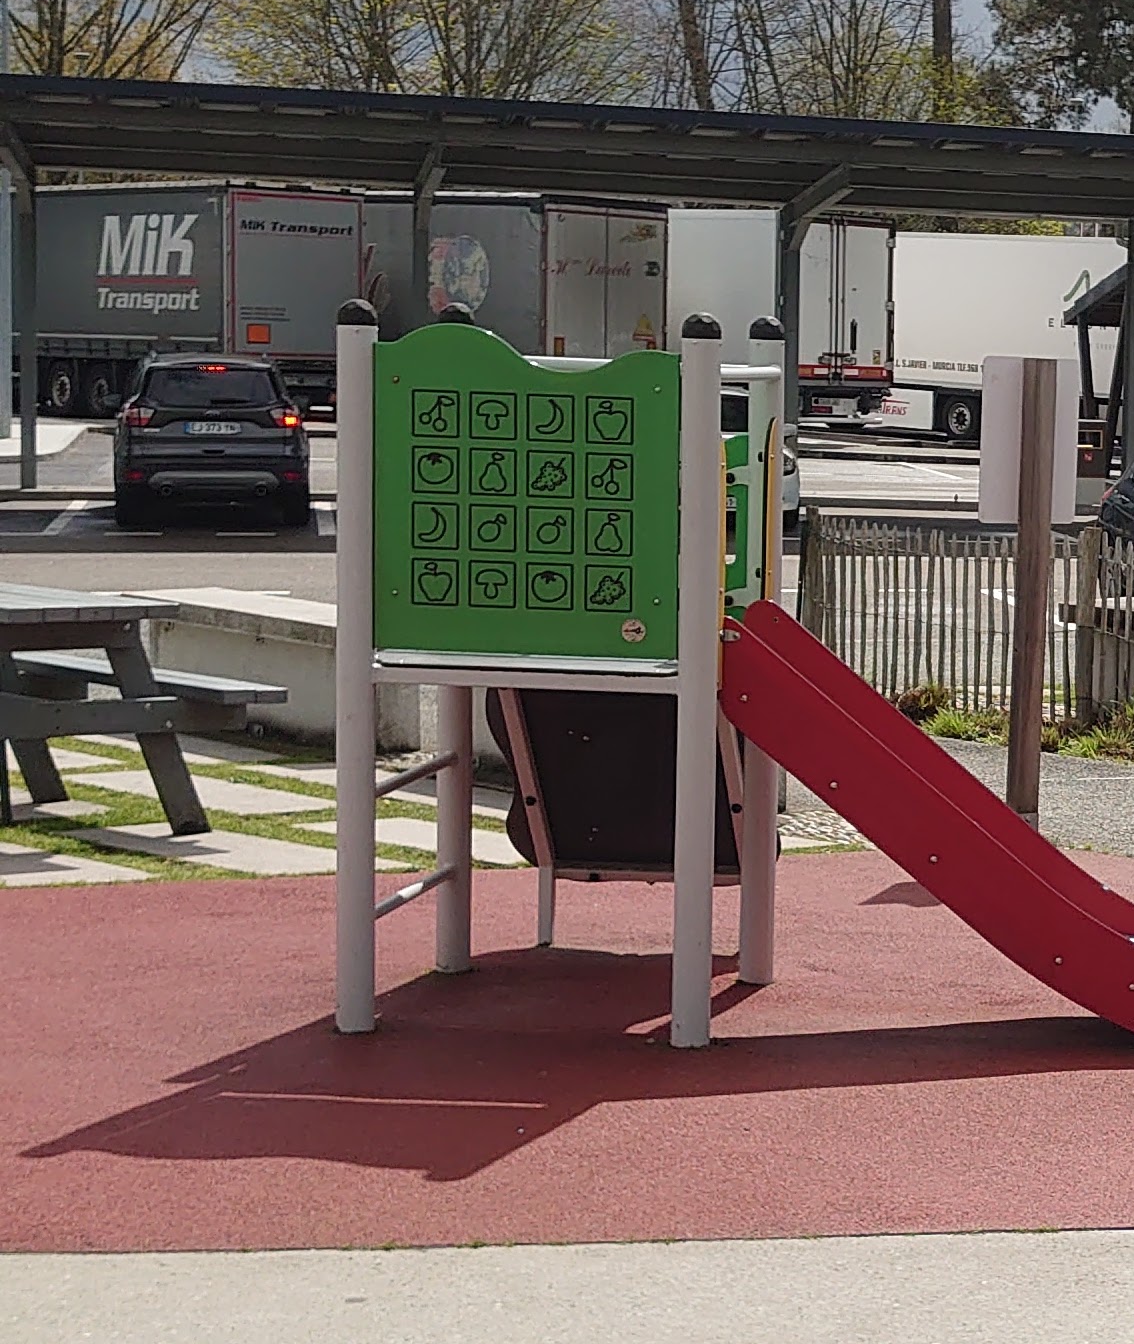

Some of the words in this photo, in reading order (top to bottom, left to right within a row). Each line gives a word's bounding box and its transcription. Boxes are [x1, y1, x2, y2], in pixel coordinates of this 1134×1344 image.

[271, 221, 354, 236] Transport
[98, 214, 199, 275] MiK
[98, 287, 200, 314] Transport
